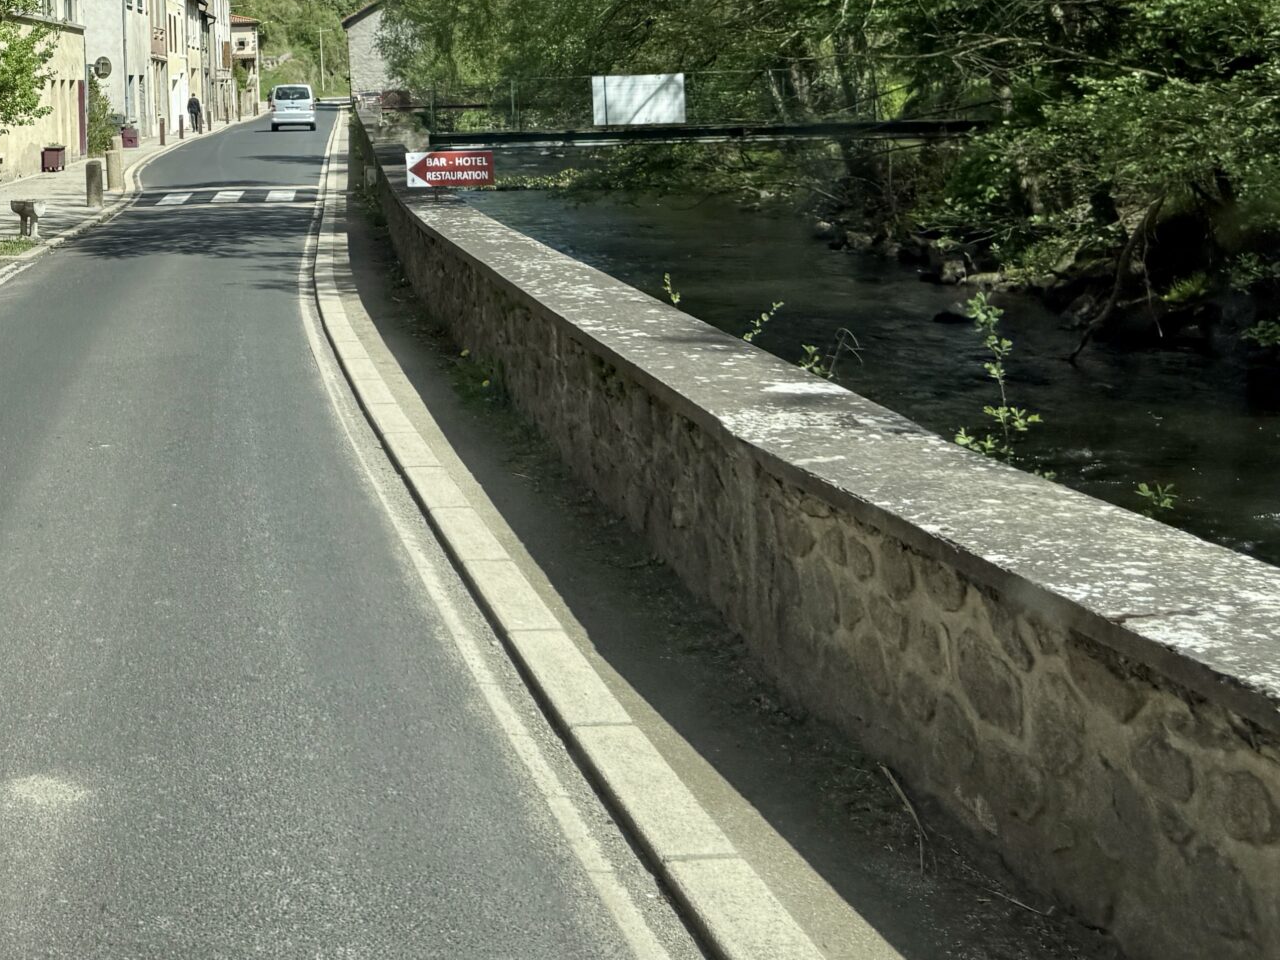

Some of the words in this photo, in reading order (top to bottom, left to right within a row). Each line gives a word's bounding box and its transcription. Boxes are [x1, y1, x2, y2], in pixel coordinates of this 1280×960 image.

[426, 157, 447, 167] BAR
[455, 156, 488, 166] HOTEL
[426, 170, 489, 181] RESTAURATION
